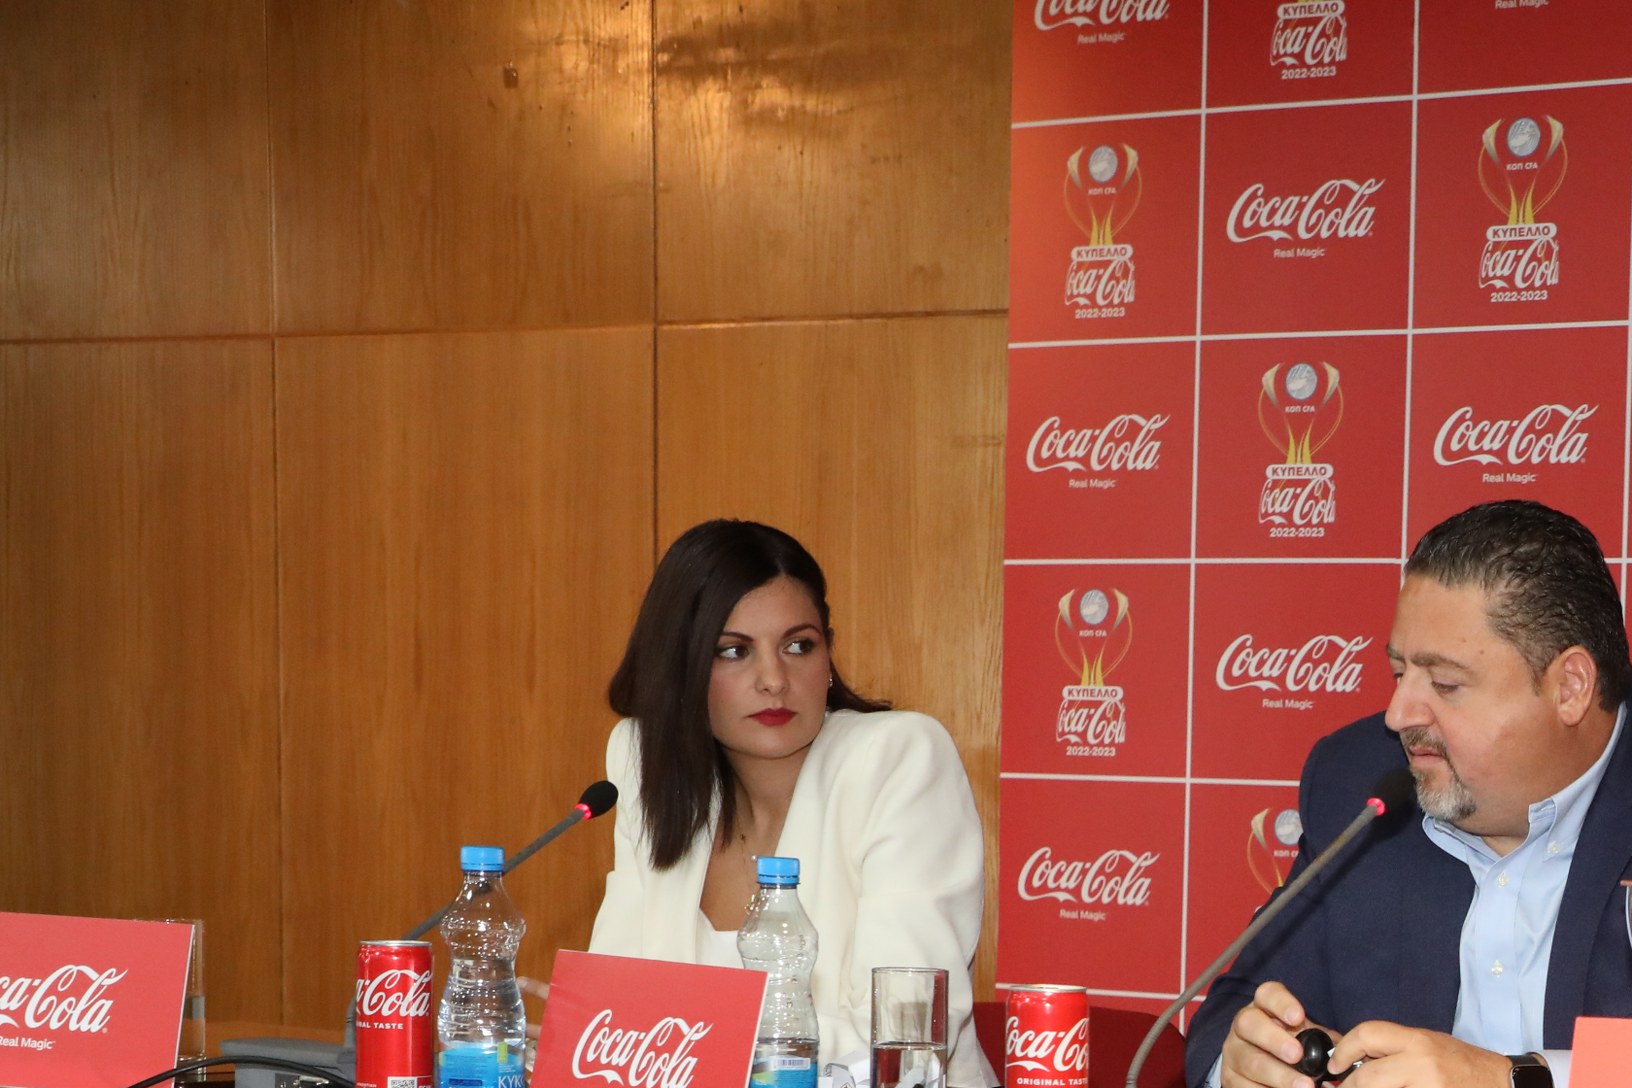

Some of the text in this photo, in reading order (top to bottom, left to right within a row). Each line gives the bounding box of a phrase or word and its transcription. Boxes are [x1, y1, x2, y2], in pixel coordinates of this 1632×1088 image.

[1283, 3, 1338, 16] ΚΥΠΕΛΛΟ
[1280, 65, 1338, 81] 2022-2023
[1227, 179, 1384, 241] Coca-Cola
[1493, 226, 1550, 238] ΚΥΠΕΛΛΟ
[1077, 248, 1127, 258] ΚΥΠΕΛΛΟ
[1273, 247, 1325, 259] Real Magic
[1490, 289, 1548, 303] 2022-2023
[1075, 306, 1126, 319] 2022-2023
[1434, 404, 1597, 465] Coca-Cola
[1027, 414, 1169, 472] Coca-Cola
[1272, 466, 1327, 477] ΚΥΠΕΛΛΟ
[1068, 478, 1116, 490] Real Magic
[1482, 472, 1536, 485] Real Magic
[1269, 527, 1325, 538] 2022-2023
[1216, 635, 1371, 692] Coca-Cola
[1067, 688, 1118, 698] ΚΥΠΕΛΛΟ
[1262, 698, 1313, 711] Real Magic
[1066, 745, 1116, 757] 2022-2023
[1018, 847, 1159, 905] Coca-Cola
[1059, 908, 1106, 922] Real Magic
[0, 964, 128, 1033] a-Cola
[1017, 1077, 1065, 1086] ORIGINAL
